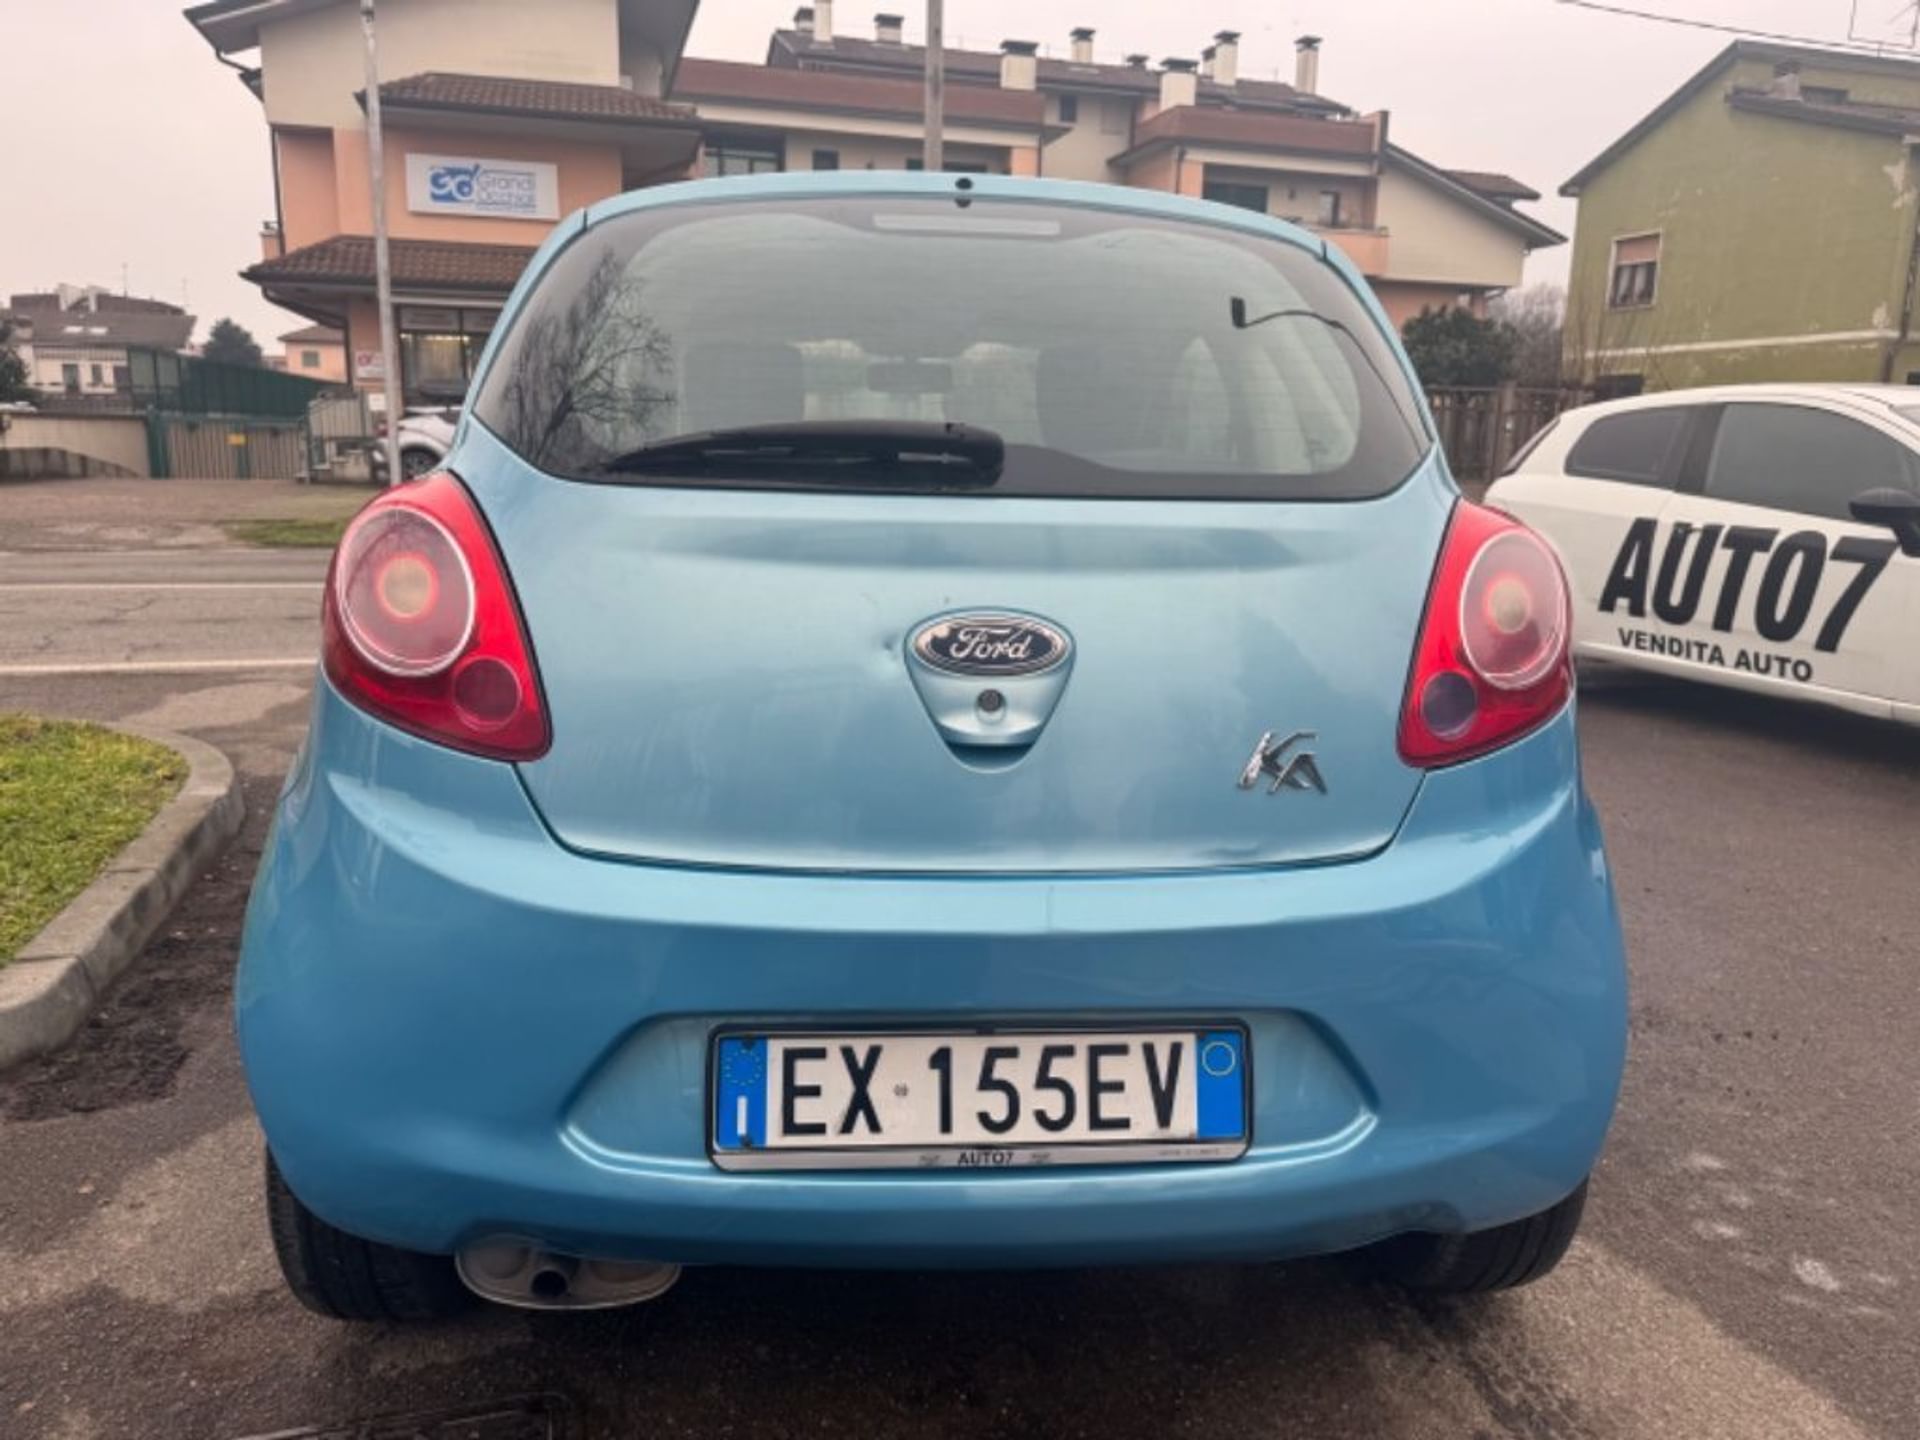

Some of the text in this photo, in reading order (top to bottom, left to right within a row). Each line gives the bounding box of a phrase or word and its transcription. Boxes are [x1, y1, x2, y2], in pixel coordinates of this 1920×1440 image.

[1597, 516, 1898, 654] AUTO7
[950, 627, 1032, 659] Ford
[1617, 627, 1814, 683] VENDITA AUTO
[781, 1044, 884, 1137] EX
[928, 1041, 1184, 1136] 155EV
[957, 1150, 1015, 1168] AUTO7
